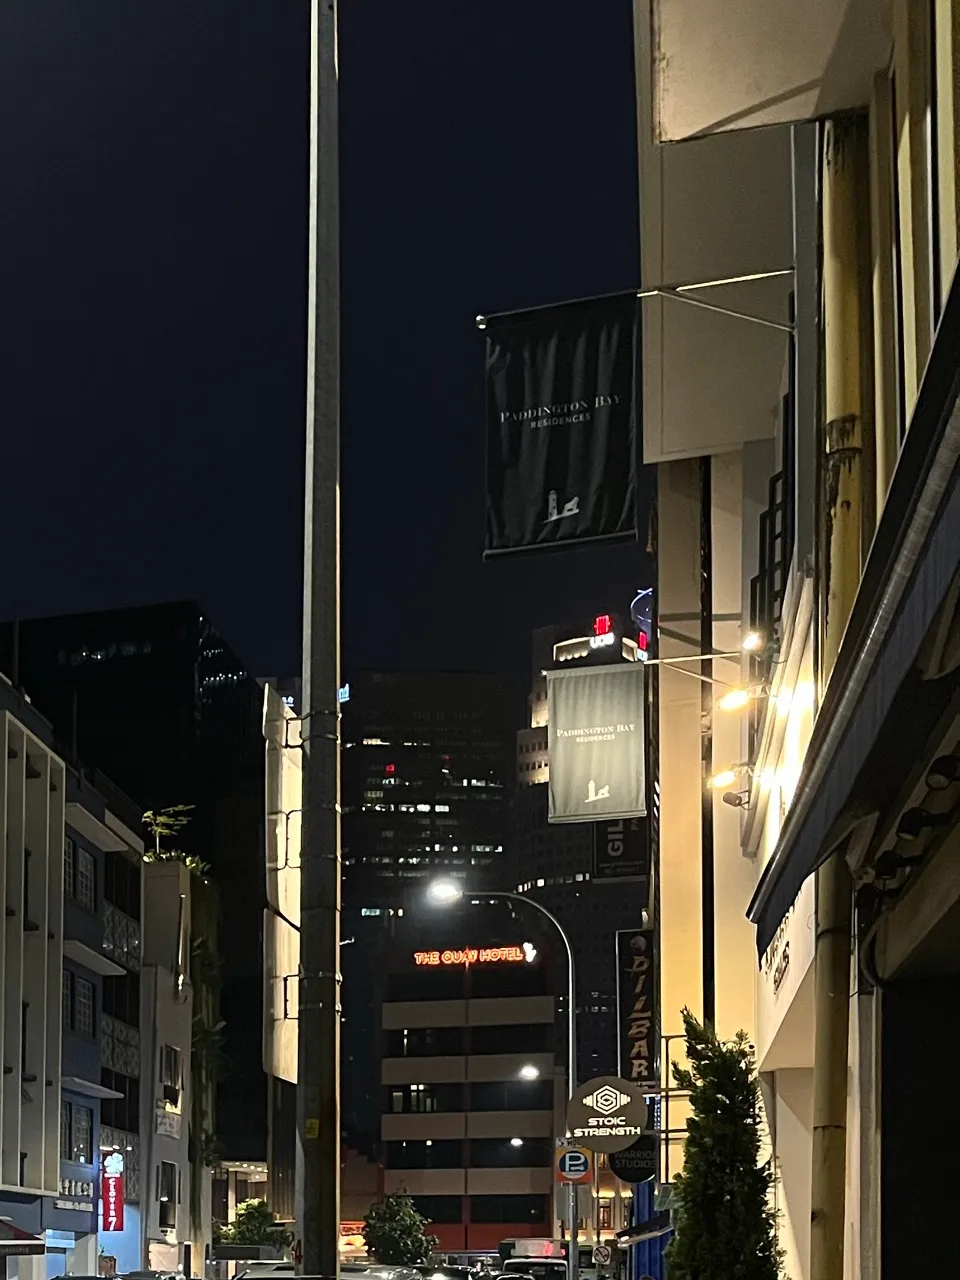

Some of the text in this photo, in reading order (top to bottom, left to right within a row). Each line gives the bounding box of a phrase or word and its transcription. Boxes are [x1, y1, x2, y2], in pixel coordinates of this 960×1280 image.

[500, 394, 622, 423] PADDINGTON BAY
[530, 412, 591, 428] RESIDENCES
[556, 723, 635, 737] PADDINGTON BAY
[576, 733, 616, 743] RESIDENCES
[414, 946, 524, 965] THE QUAY HOTEL
[587, 1116, 626, 1126] STOIC
[573, 1126, 641, 1137] STRENGTH
[108, 1217, 118, 1231] 7
